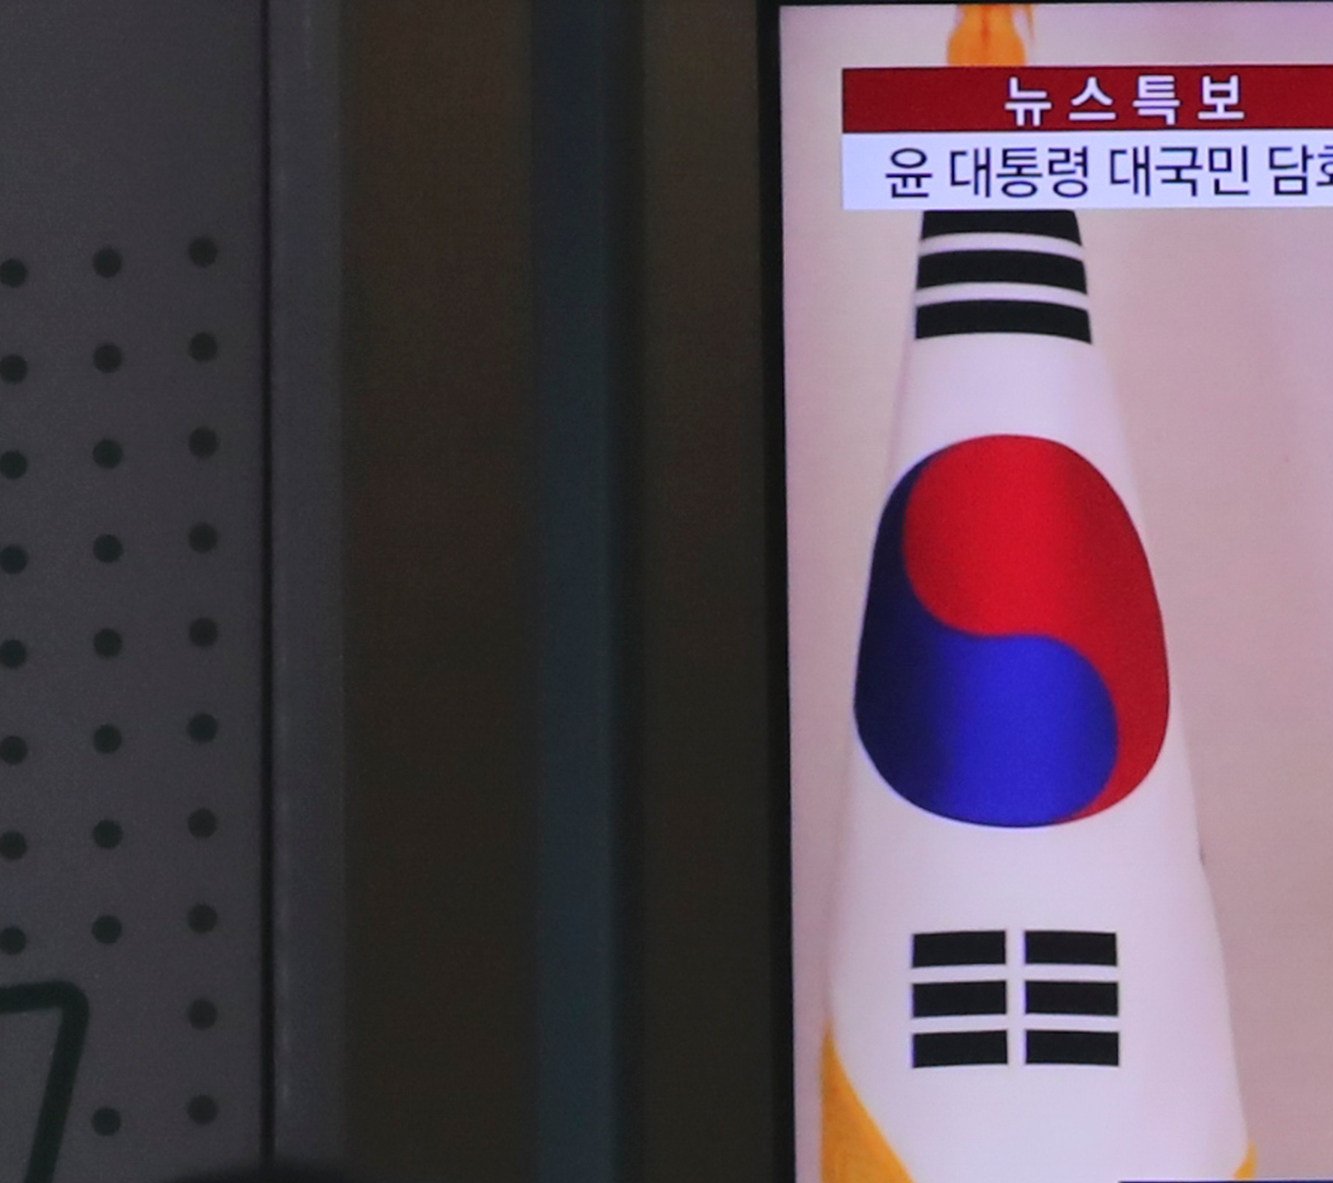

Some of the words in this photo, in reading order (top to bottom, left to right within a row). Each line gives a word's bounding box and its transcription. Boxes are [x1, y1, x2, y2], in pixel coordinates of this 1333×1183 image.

[884, 148, 932, 198] 윤
[949, 145, 1090, 198] 대통령
[1109, 144, 1250, 196] 대국민
